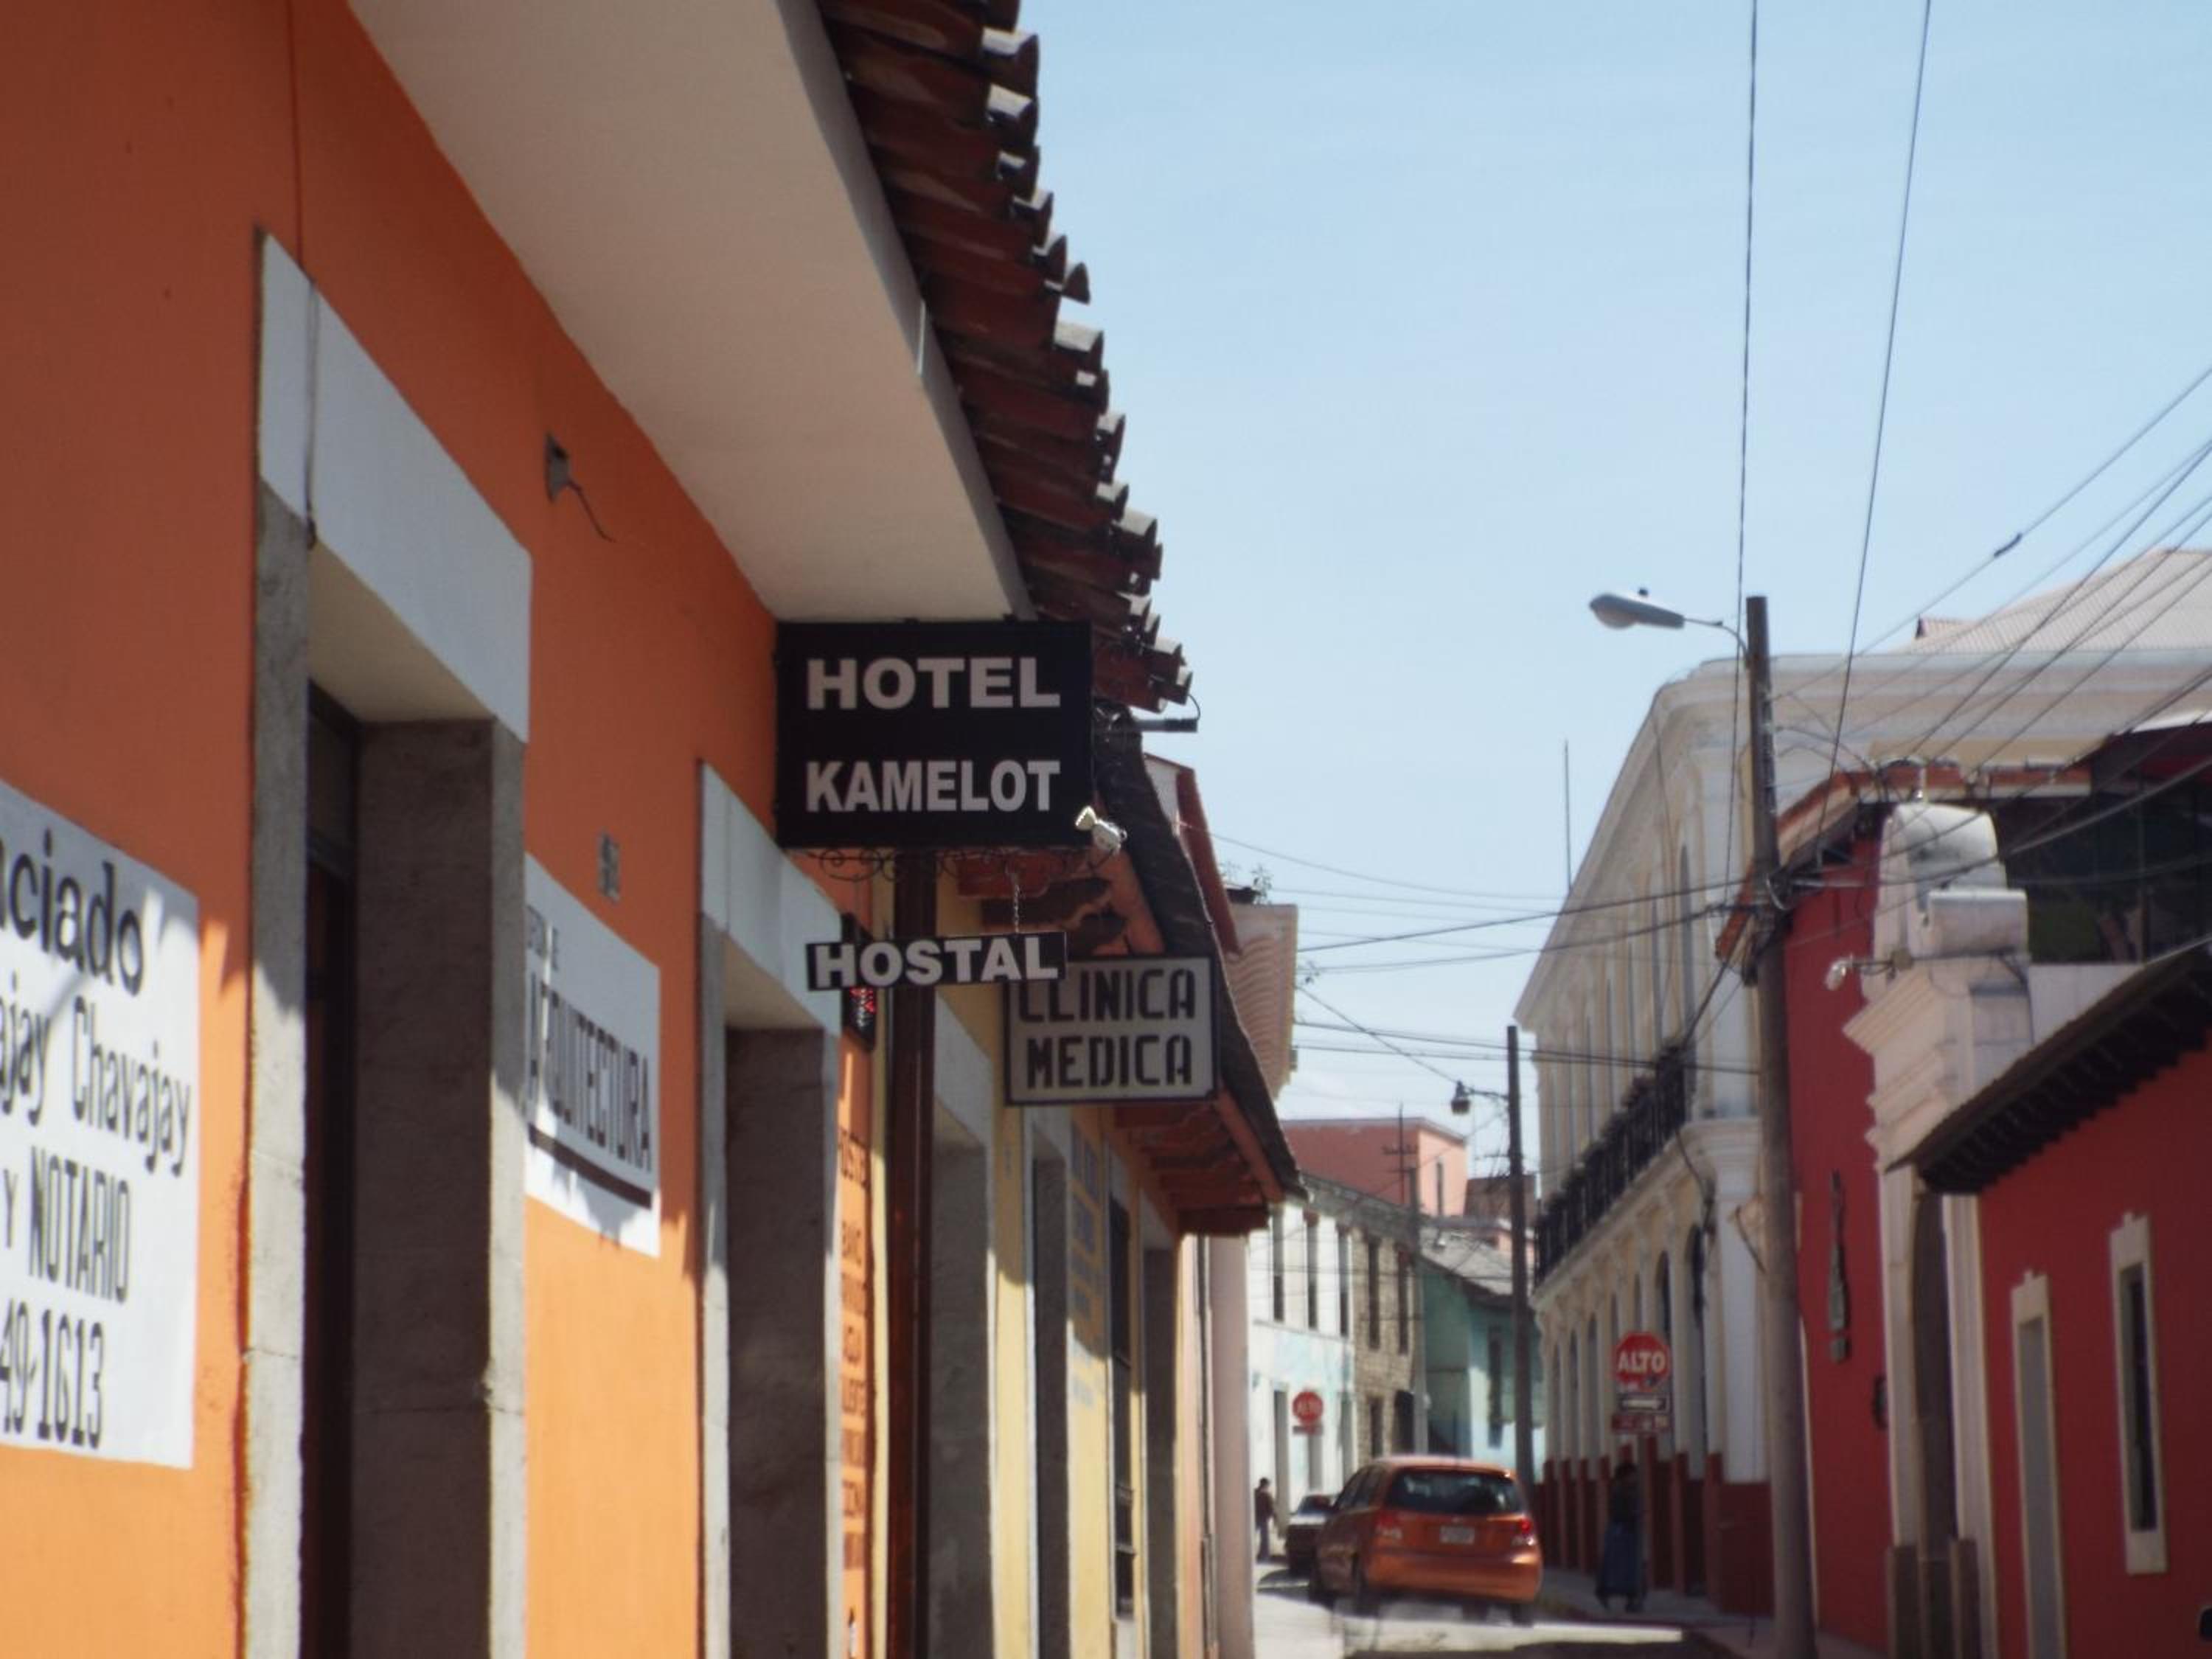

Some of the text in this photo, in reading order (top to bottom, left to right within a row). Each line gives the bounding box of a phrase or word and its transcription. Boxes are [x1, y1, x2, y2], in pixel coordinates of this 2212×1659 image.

[807, 658, 1060, 710] HOTEL
[806, 759, 1060, 813] KAMELOT
[813, 936, 1059, 988] HOSTAL
[72, 994, 192, 1178] Chavajay
[1027, 1034, 1192, 1090] MEDICA
[3, 1146, 131, 1304] Y NOTARIO
[1617, 1349, 1666, 1374] ALTO
